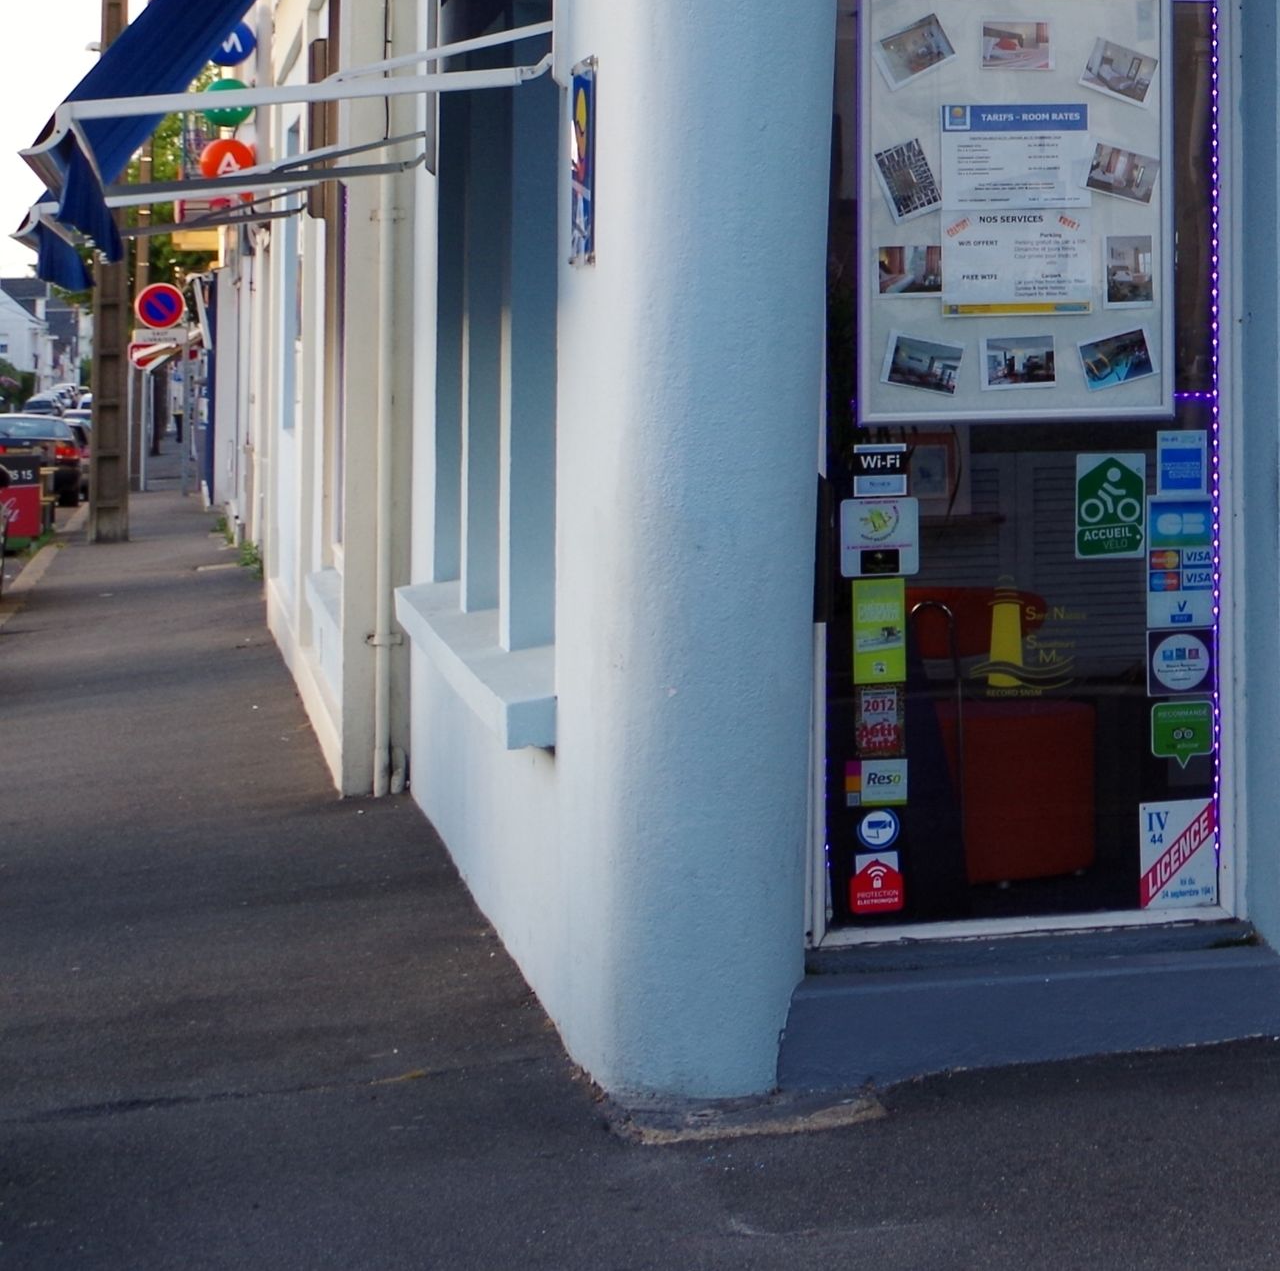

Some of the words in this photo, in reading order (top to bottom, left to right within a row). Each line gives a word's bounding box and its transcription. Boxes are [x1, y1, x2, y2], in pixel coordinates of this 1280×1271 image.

[981, 113, 1014, 122] TARIFS
[1022, 113, 1050, 121] ROOM
[1051, 112, 1081, 121] RATES
[979, 215, 998, 224] NOS
[1000, 214, 1044, 224] SERVICES
[860, 454, 901, 469] Wi-Fi
[1083, 527, 1133, 541] ACCUEIL
[1185, 550, 1211, 562] VISA
[1185, 572, 1211, 584] VISA
[1177, 600, 1188, 613] V
[863, 699, 896, 713] 2012
[867, 772, 902, 786] Reso
[1147, 811, 1169, 833] IV
[1150, 833, 1163, 845] 44
[1148, 811, 1209, 898] LICENCE
[857, 890, 899, 899] PROTECTION
